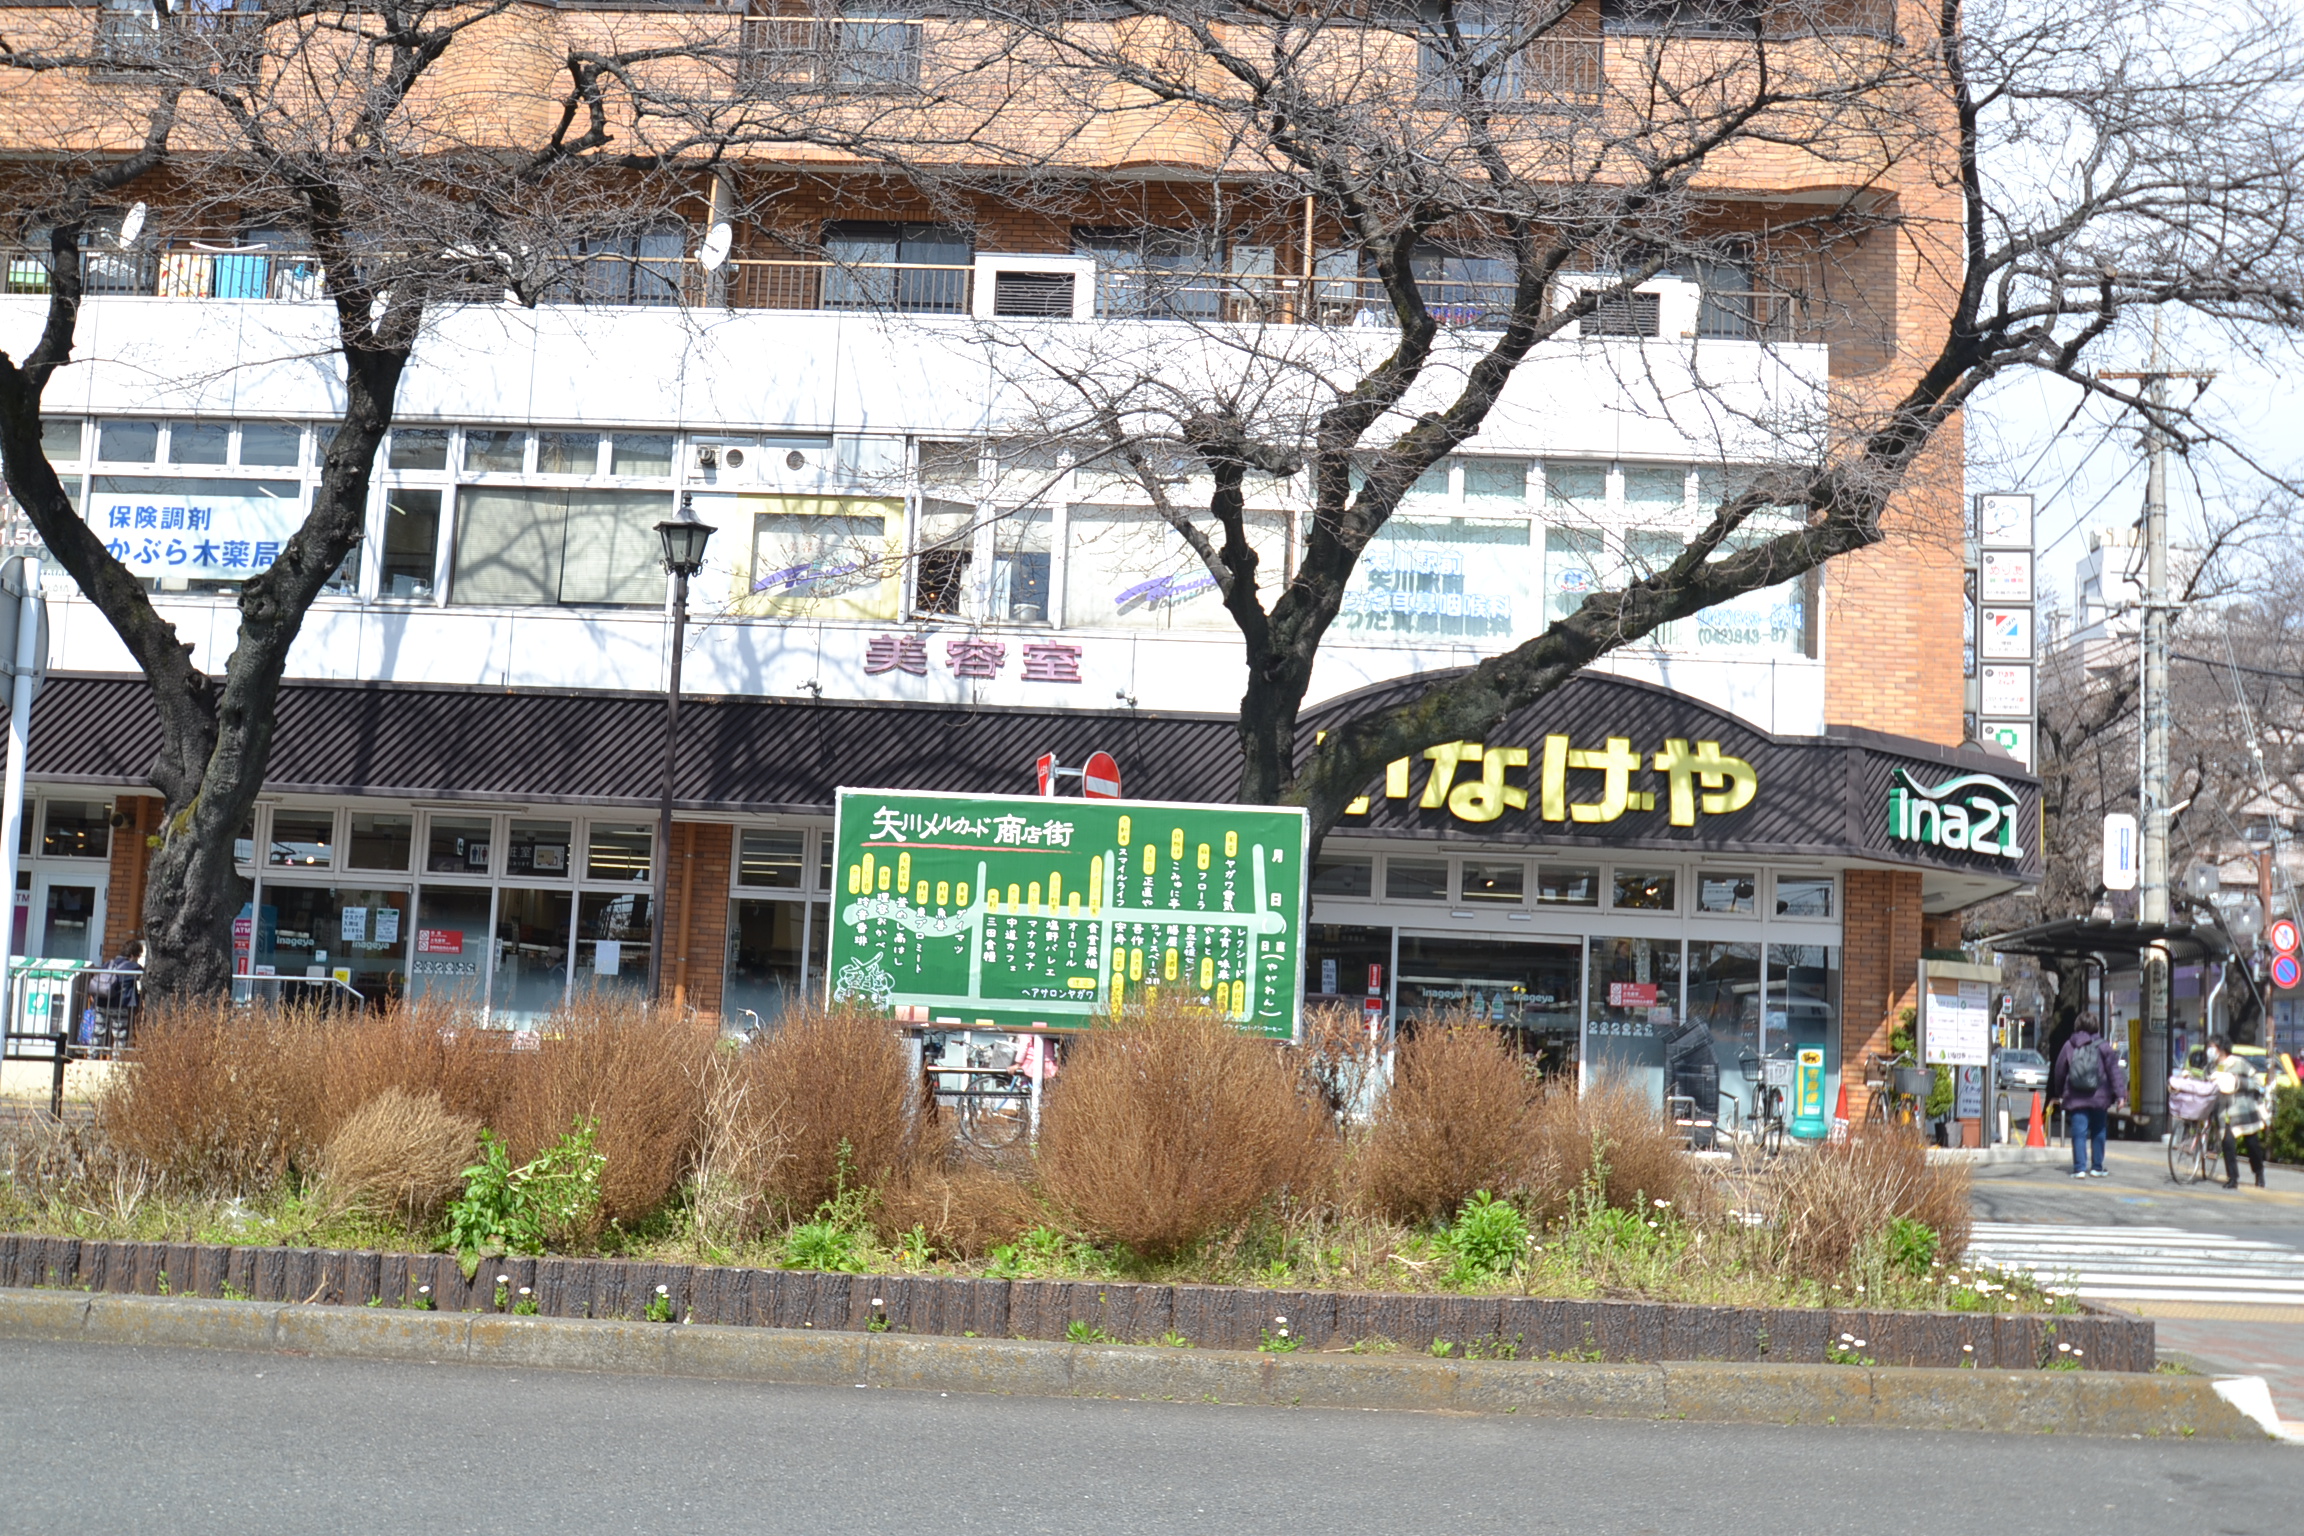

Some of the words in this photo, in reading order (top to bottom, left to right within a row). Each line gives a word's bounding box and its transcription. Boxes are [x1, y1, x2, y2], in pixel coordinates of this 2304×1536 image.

[108, 505, 211, 531] 保険調剤
[105, 537, 280, 568] かぶら木薬局
[1366, 549, 1464, 575] 矢川駅前
[863, 633, 1083, 683] 美容室
[869, 805, 1074, 847] 矢川メルカード商店街
[1890, 787, 2024, 859] ina21
[1116, 848, 1128, 907] スマイルライフ
[1272, 849, 1283, 863] 月
[1142, 876, 1154, 907] 正直や
[1197, 872, 1207, 910] フローラ
[1223, 859, 1236, 911] ヤガワ電気
[1270, 893, 1281, 907] 日
[894, 897, 908, 965] 釜めし高はし
[1005, 917, 1018, 972] 中道カフェ
[1025, 920, 1038, 971] マナカマナ
[1045, 919, 1059, 976] 塩野バレエ
[1066, 922, 1078, 967] オーロール
[1148, 924, 1161, 975] カットスペース
[1203, 926, 1215, 955] やまと
[1235, 928, 1246, 978] レクシード
[1022, 988, 1094, 1000] ヘアサロンヤガワ
